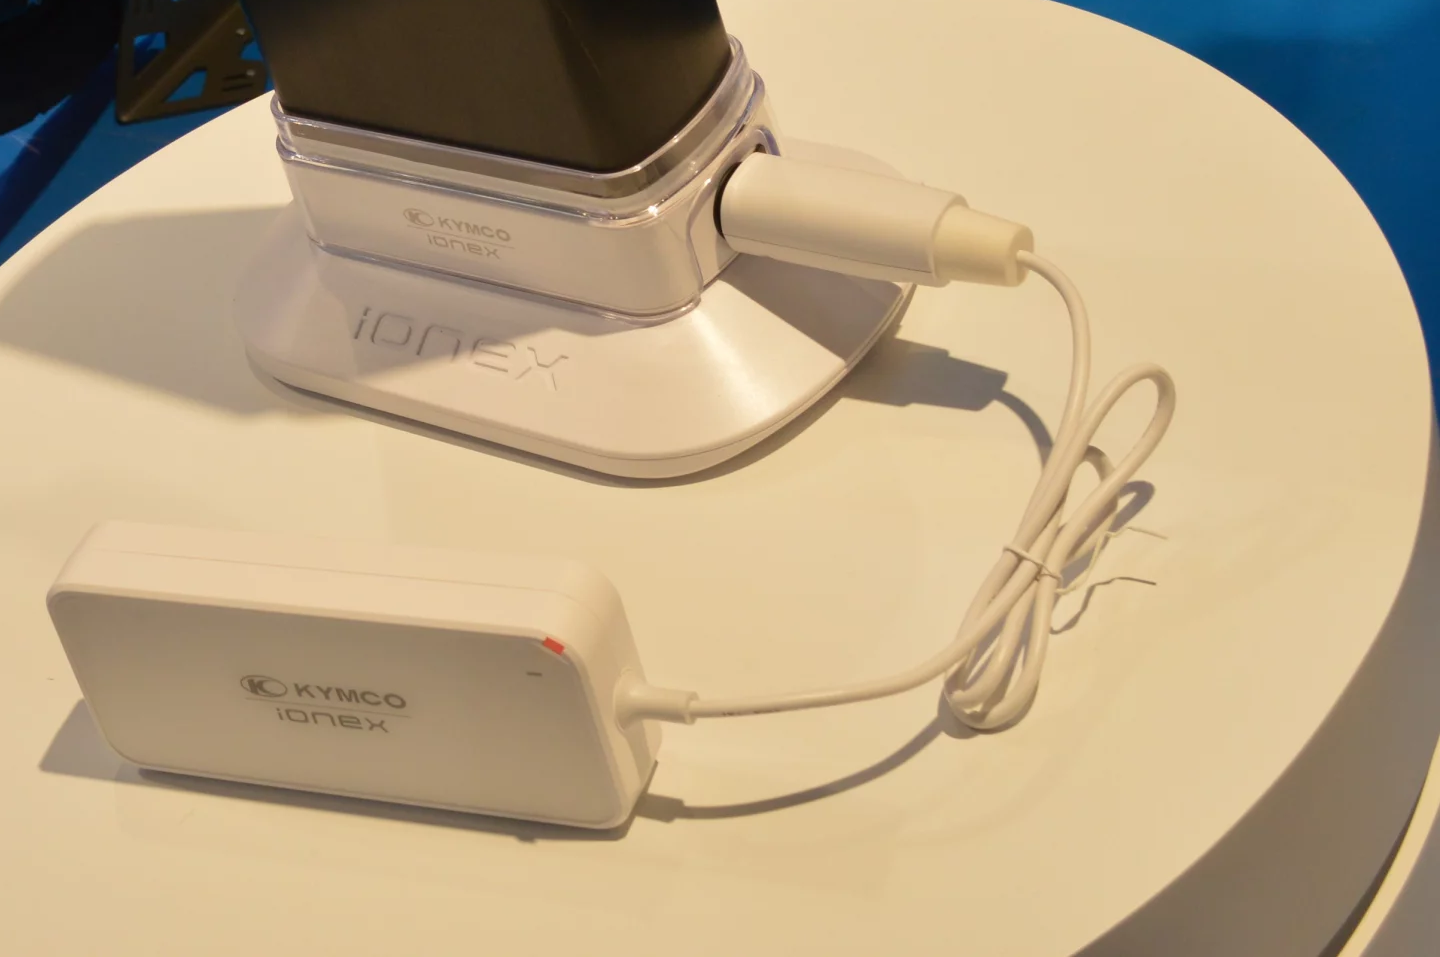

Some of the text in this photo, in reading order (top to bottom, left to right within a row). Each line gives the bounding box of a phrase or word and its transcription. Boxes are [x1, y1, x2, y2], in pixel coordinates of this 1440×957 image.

[437, 216, 511, 242] KYMCO
[426, 233, 500, 260] ionex
[354, 307, 569, 391] ionex
[294, 682, 407, 710] KYMCO
[275, 707, 389, 734] ionex
